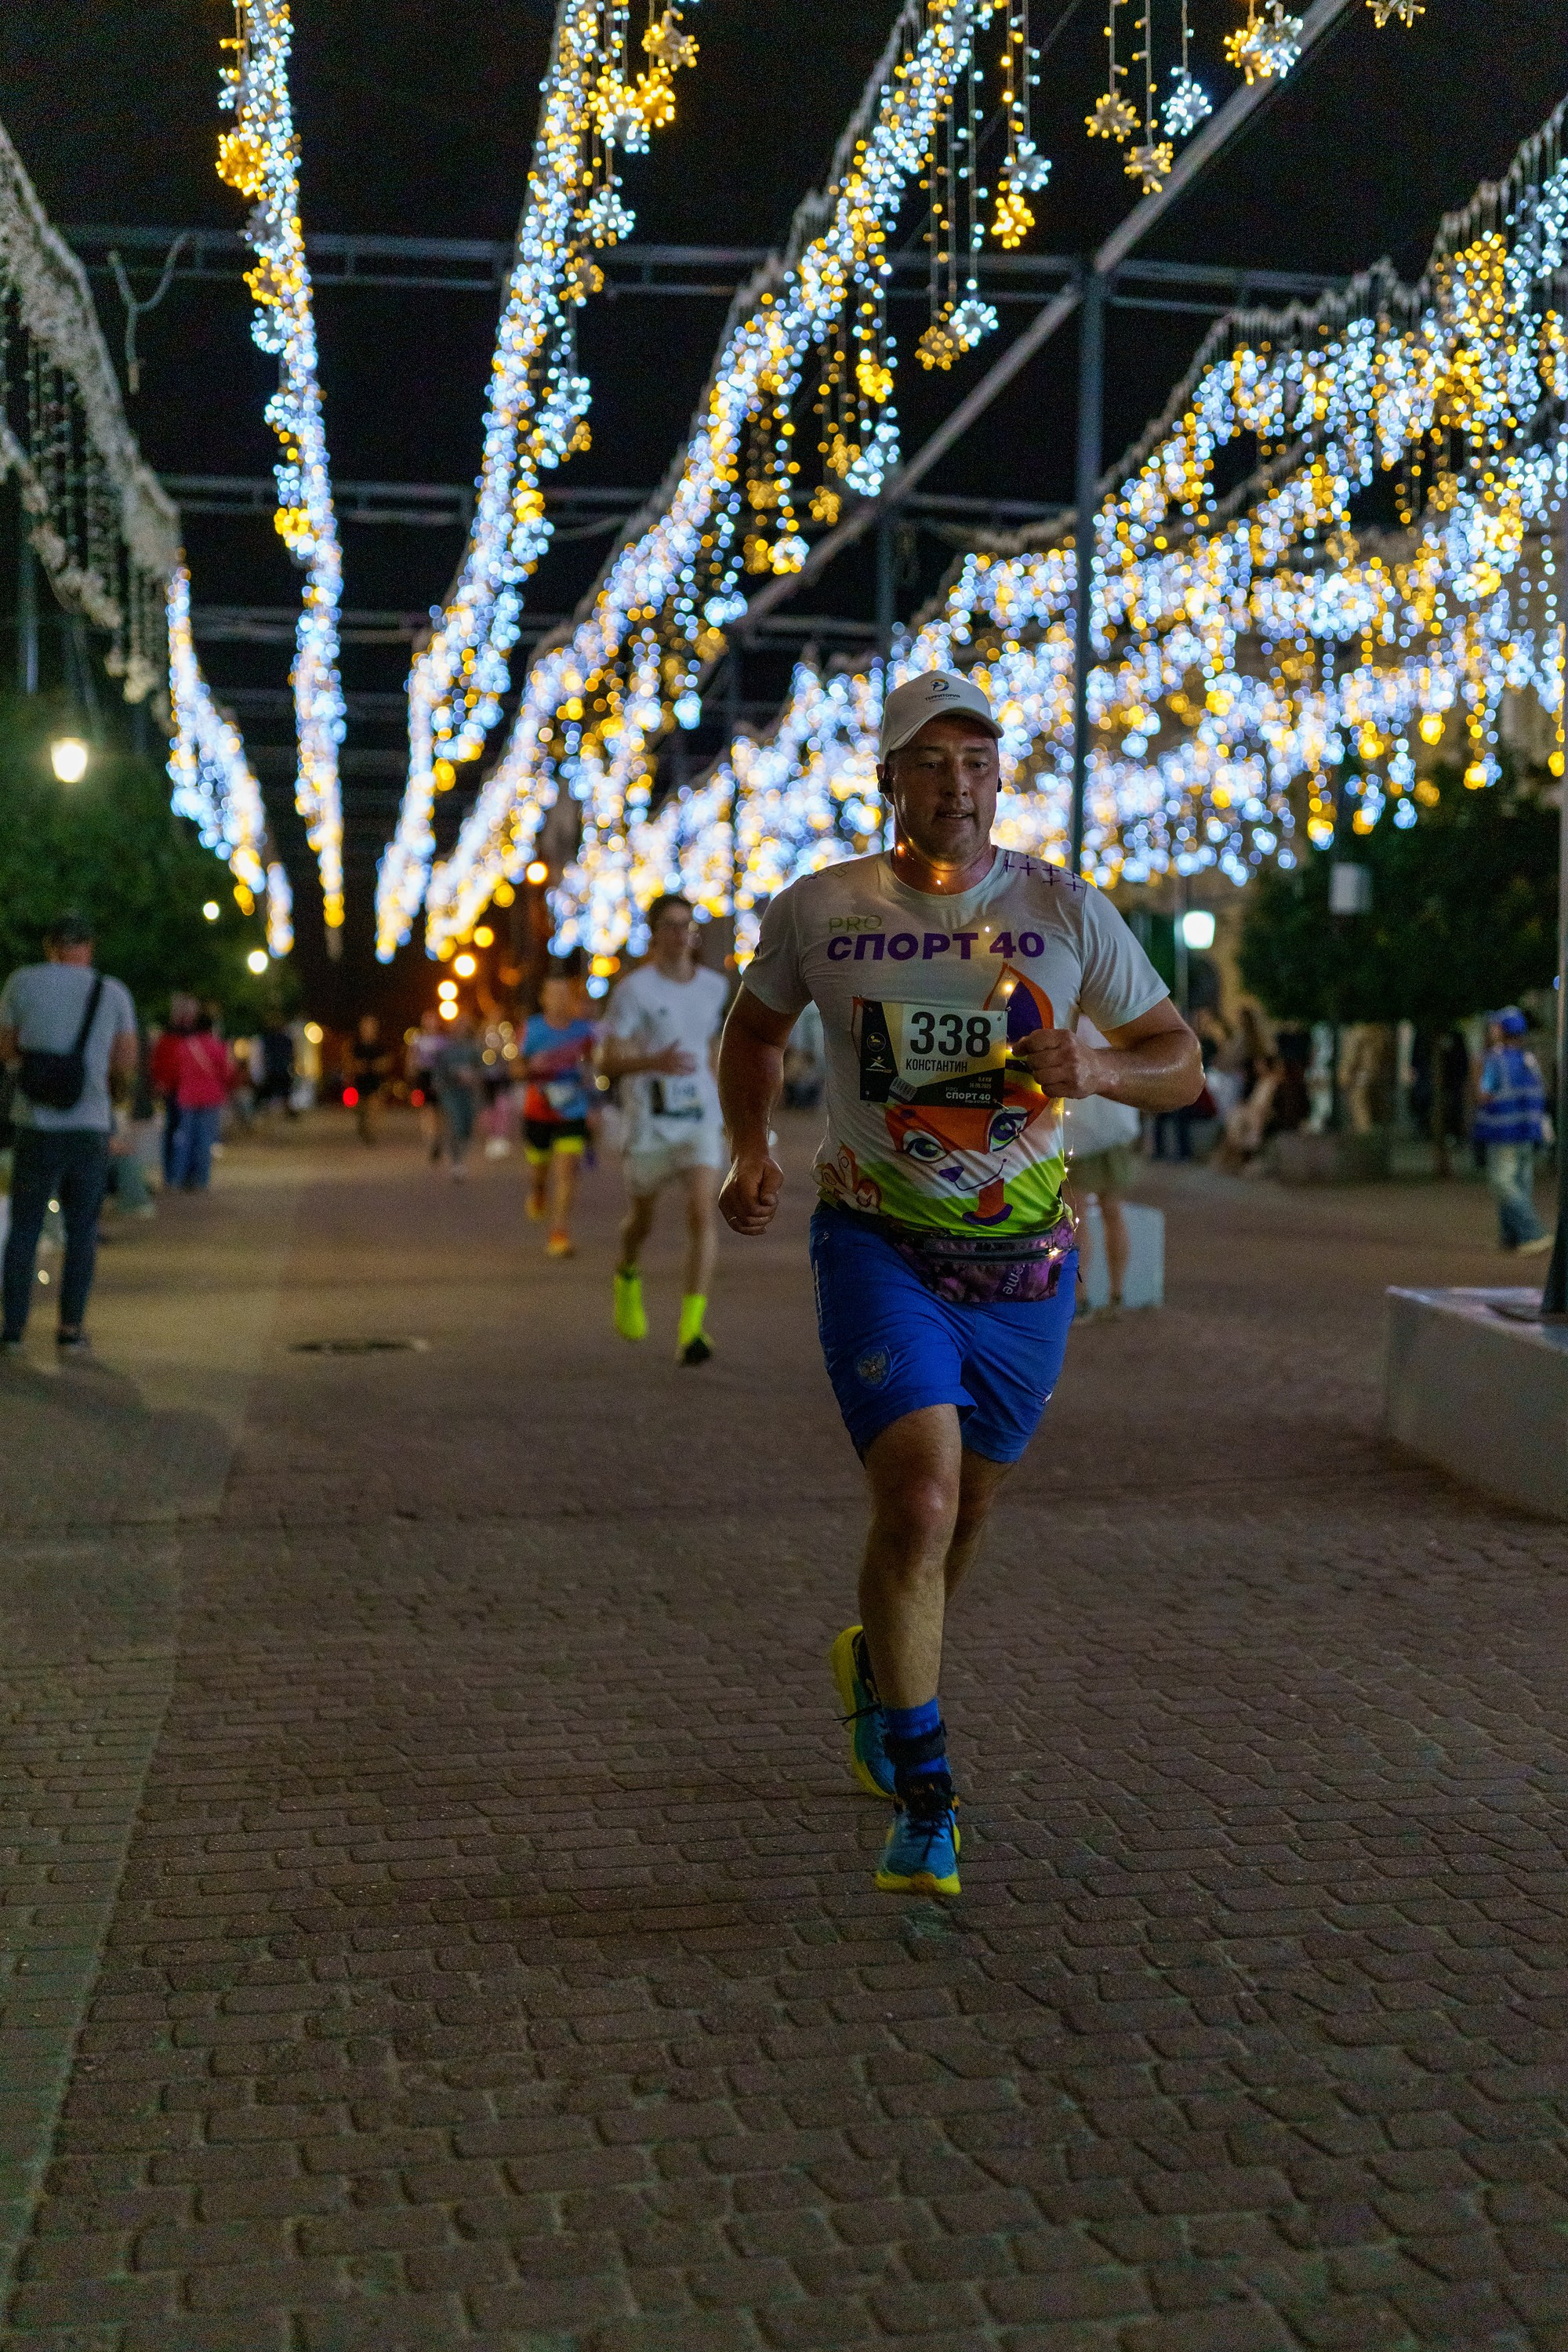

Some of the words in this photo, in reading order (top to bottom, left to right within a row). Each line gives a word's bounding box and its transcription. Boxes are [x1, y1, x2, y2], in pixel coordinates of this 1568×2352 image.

[828, 914, 882, 934] PRO
[827, 932, 979, 960] СПОРТ
[989, 931, 1045, 959] 40
[910, 1011, 992, 1058] 338
[906, 1058, 968, 1073] КОНСТАНТИН
